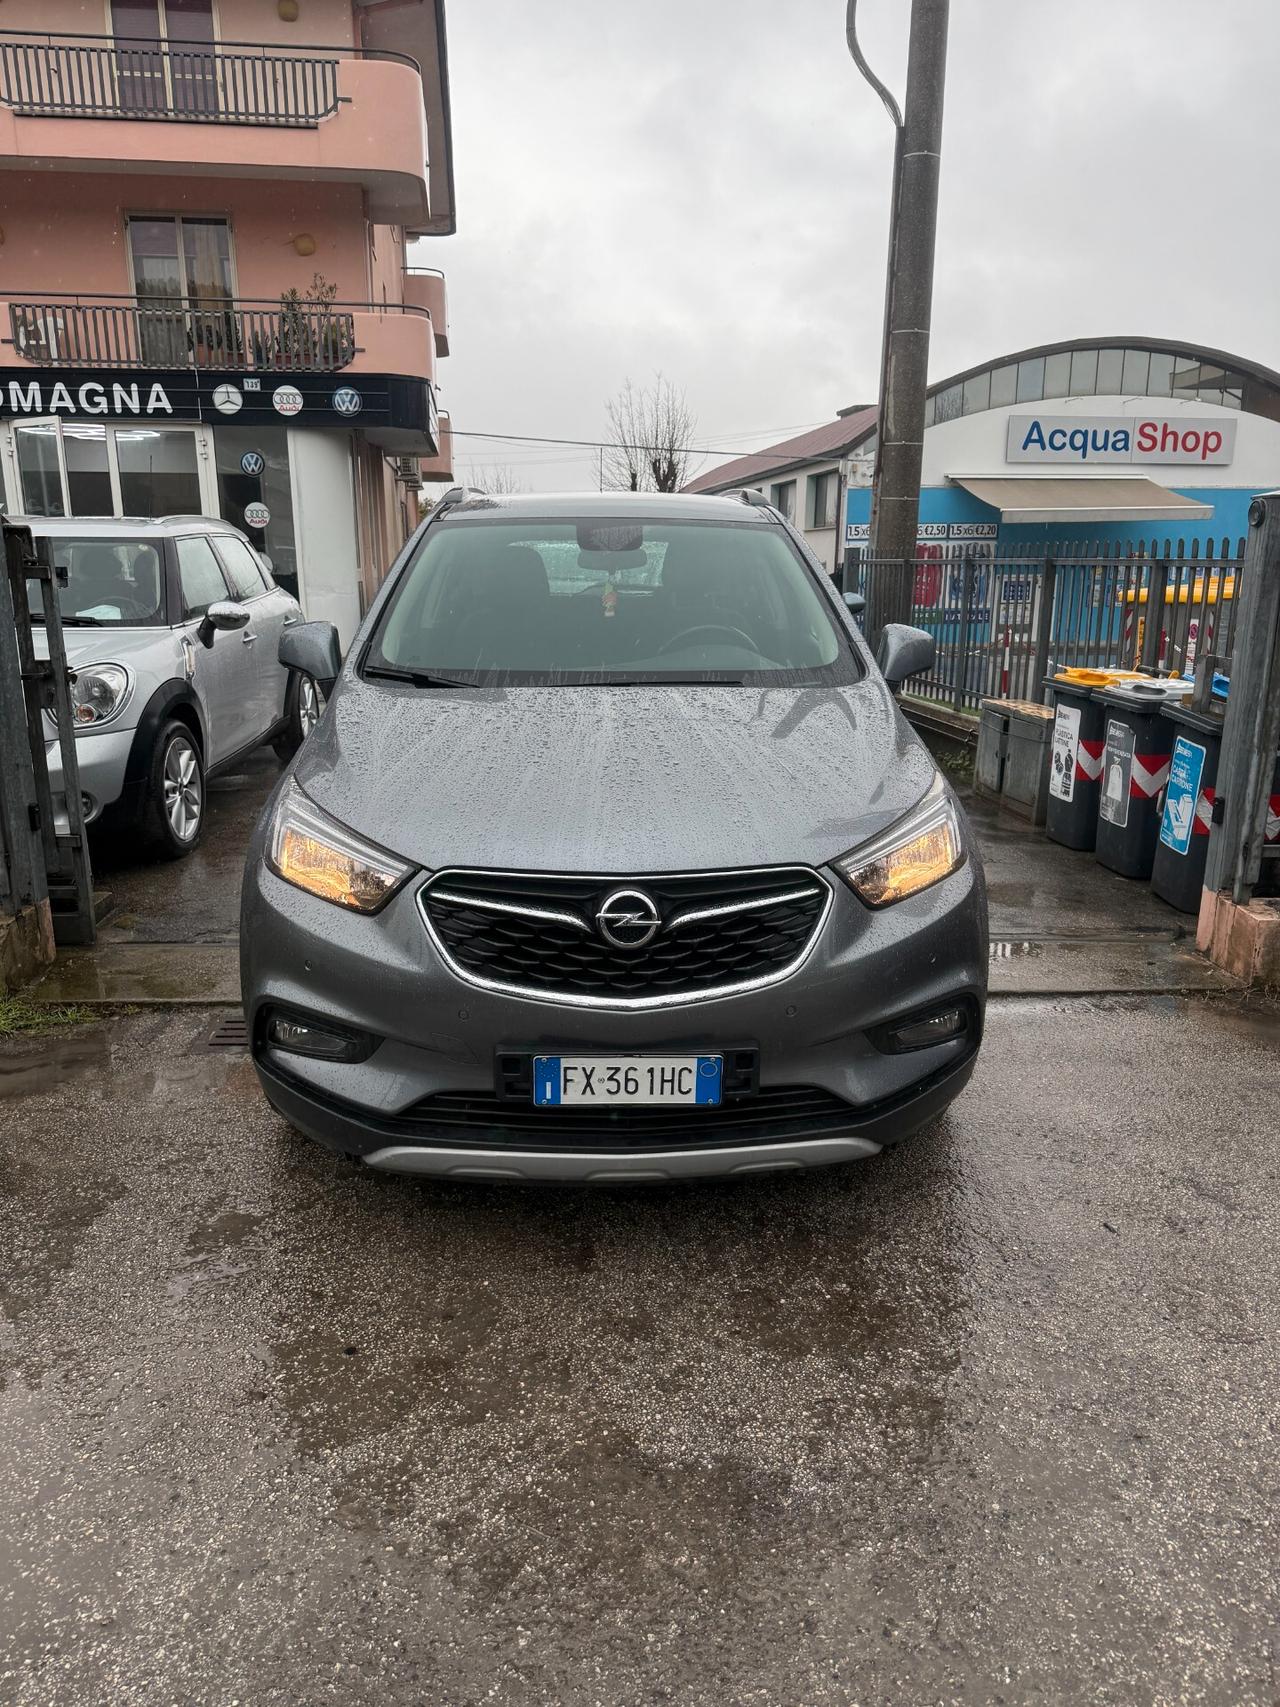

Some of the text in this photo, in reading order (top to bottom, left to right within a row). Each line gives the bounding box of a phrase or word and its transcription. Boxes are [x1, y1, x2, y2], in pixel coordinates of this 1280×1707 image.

[0, 381, 173, 414] MAGNA
[278, 403, 300, 412] Audi
[848, 526, 860, 537] 1,5
[925, 525, 946, 536] €2,50
[951, 525, 962, 536] 1,5
[975, 525, 996, 536] €2,20
